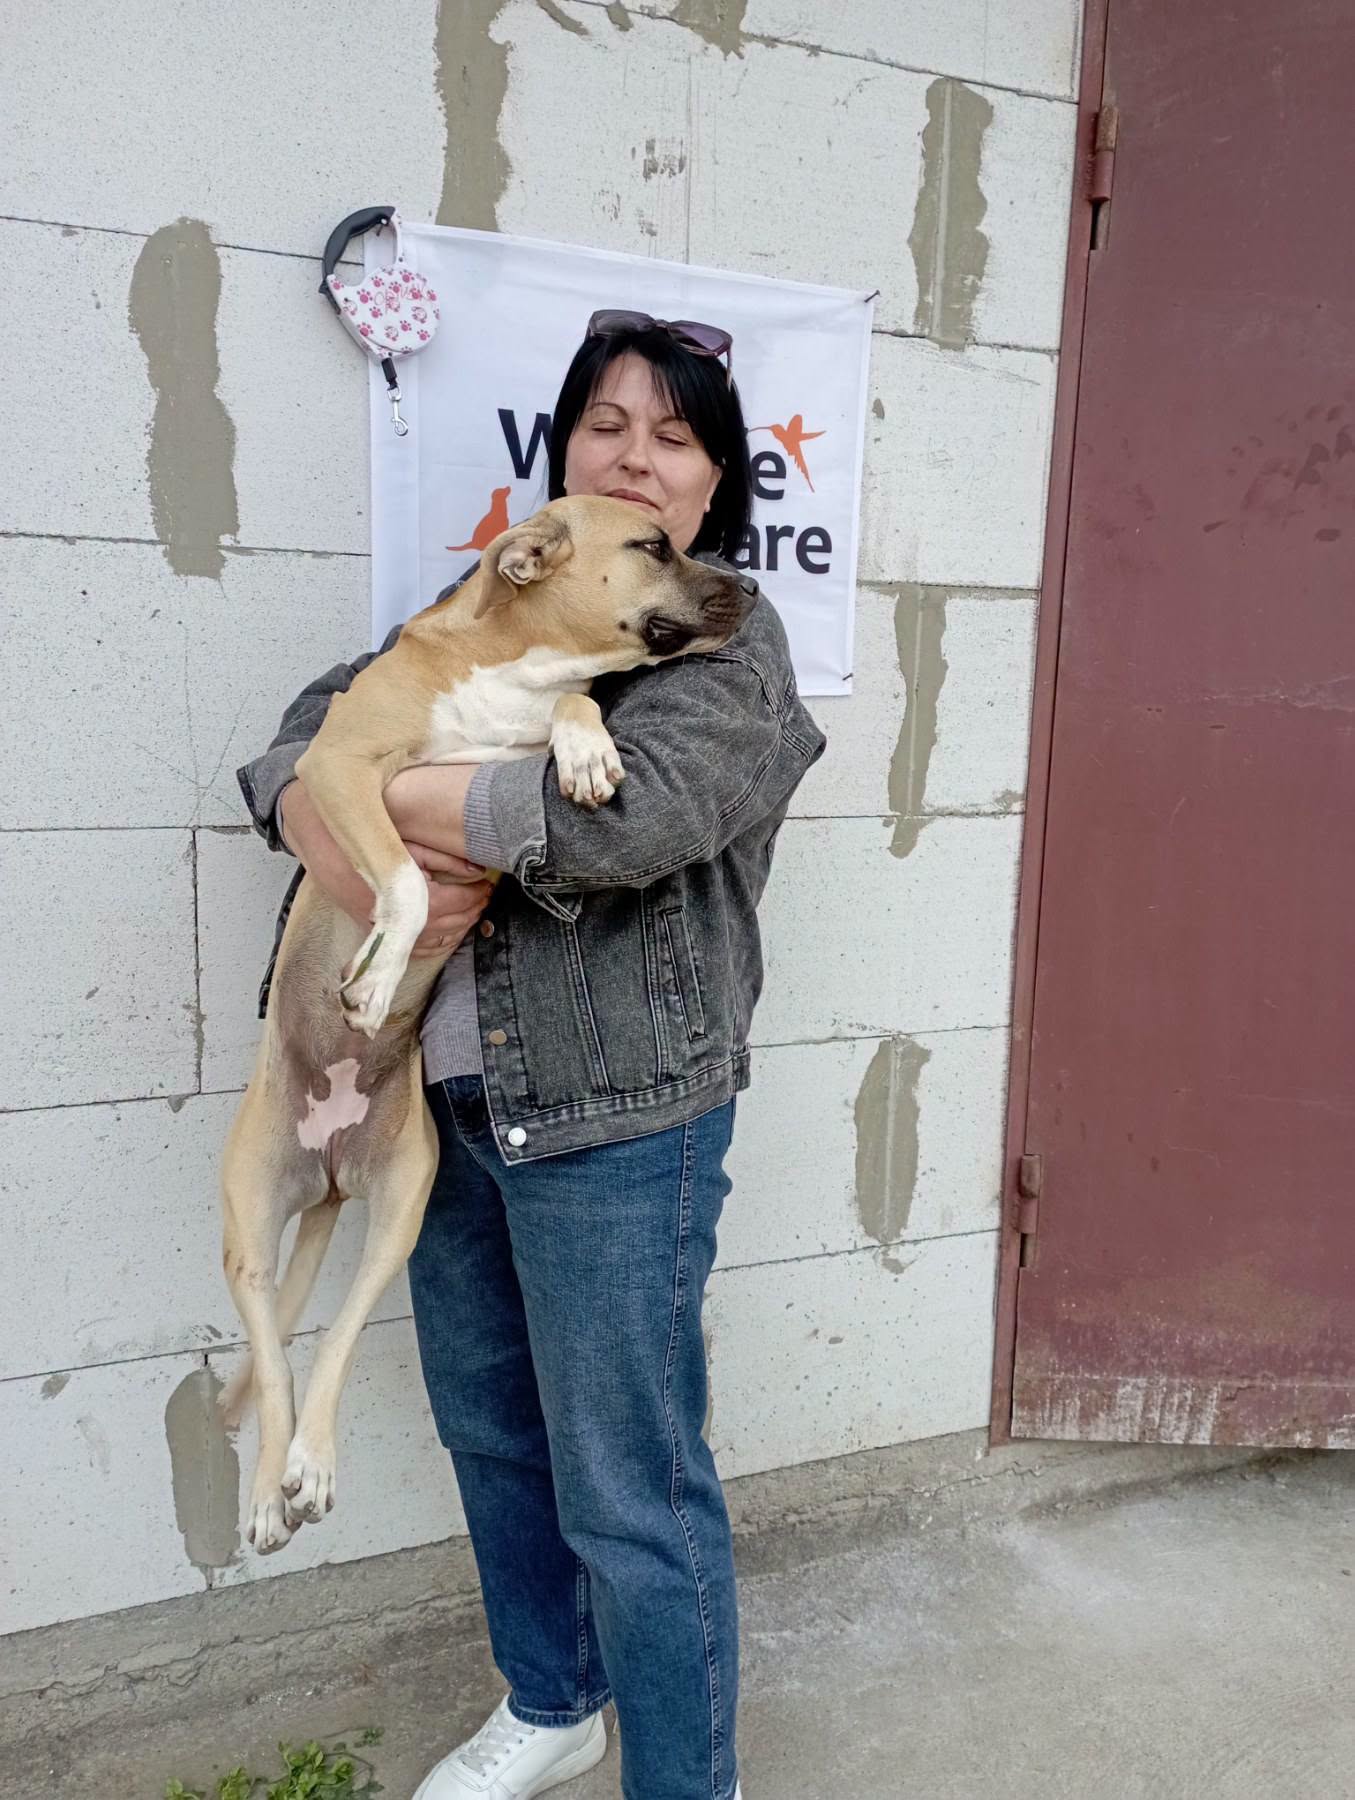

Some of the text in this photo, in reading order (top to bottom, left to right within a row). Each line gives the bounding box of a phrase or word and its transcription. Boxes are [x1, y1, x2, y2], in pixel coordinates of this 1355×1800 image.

[498, 408, 787, 500] W e
[734, 524, 833, 574] are
